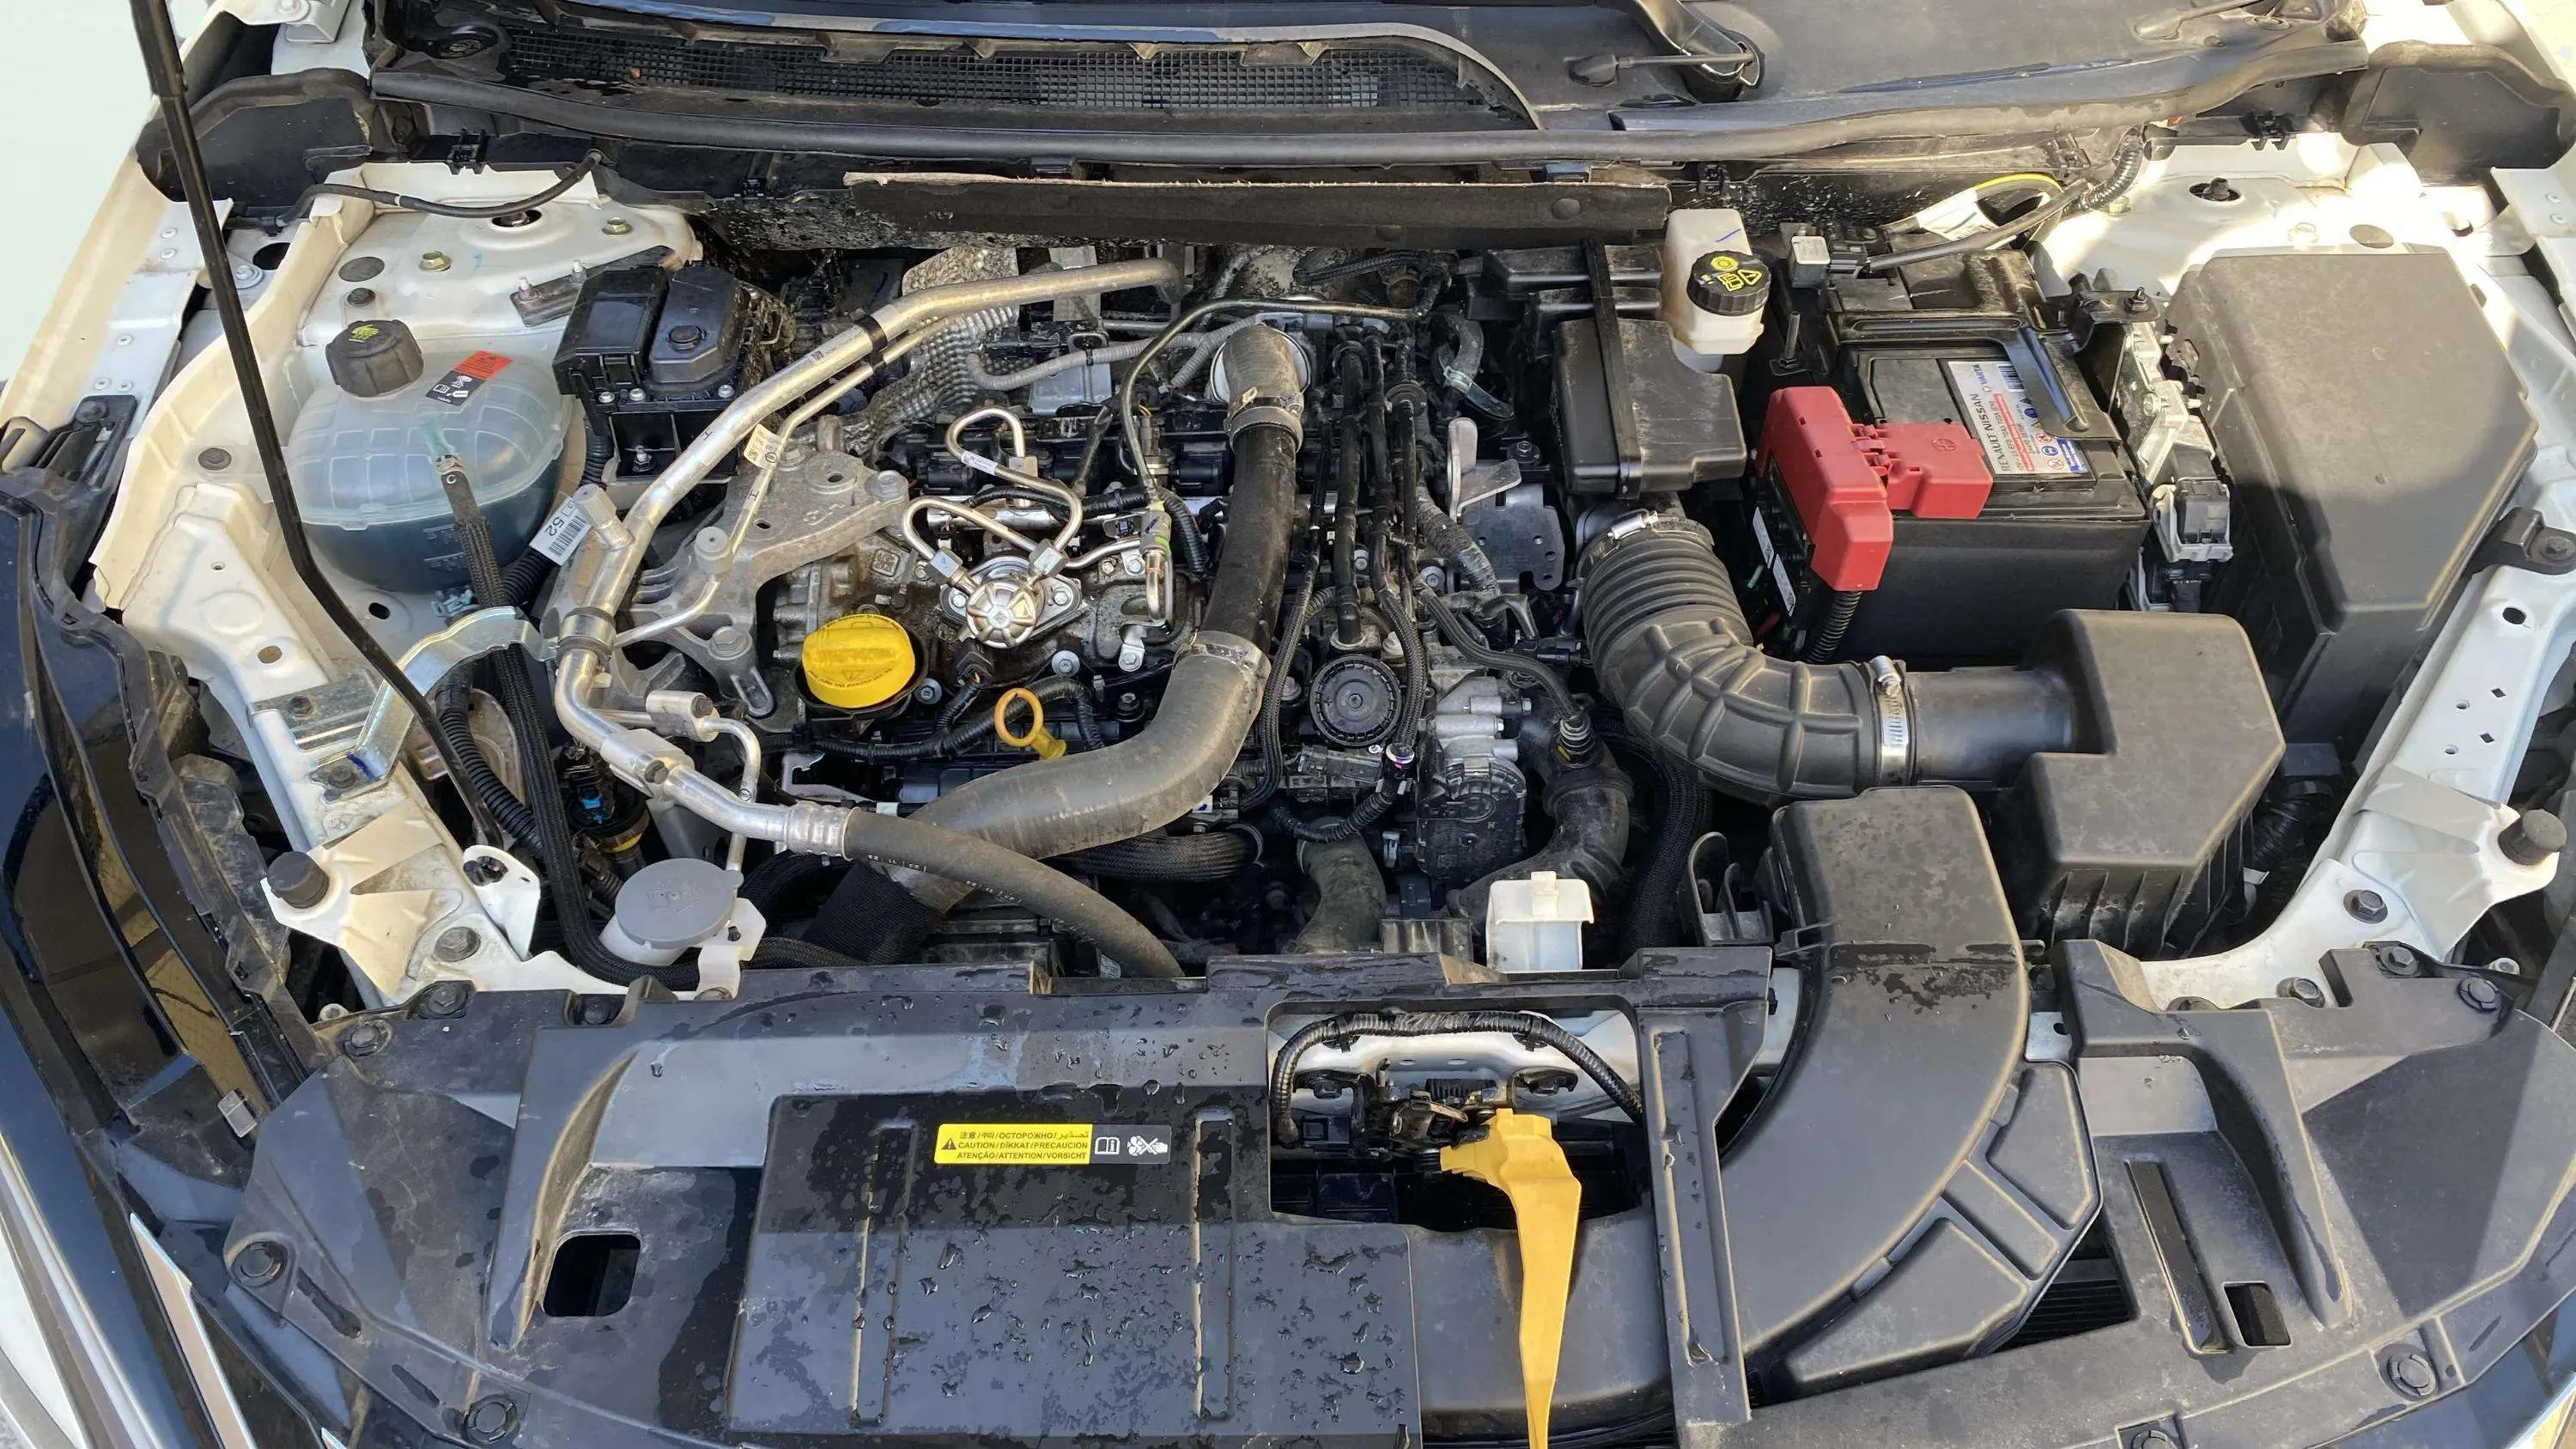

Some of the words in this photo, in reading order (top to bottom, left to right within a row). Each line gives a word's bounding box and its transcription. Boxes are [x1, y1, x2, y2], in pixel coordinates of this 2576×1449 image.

[1972, 364, 1988, 385] VARTA
[1970, 393, 1994, 431] NISSAN
[1987, 433, 2011, 472] RENAULT
[544, 516, 565, 537] 52
